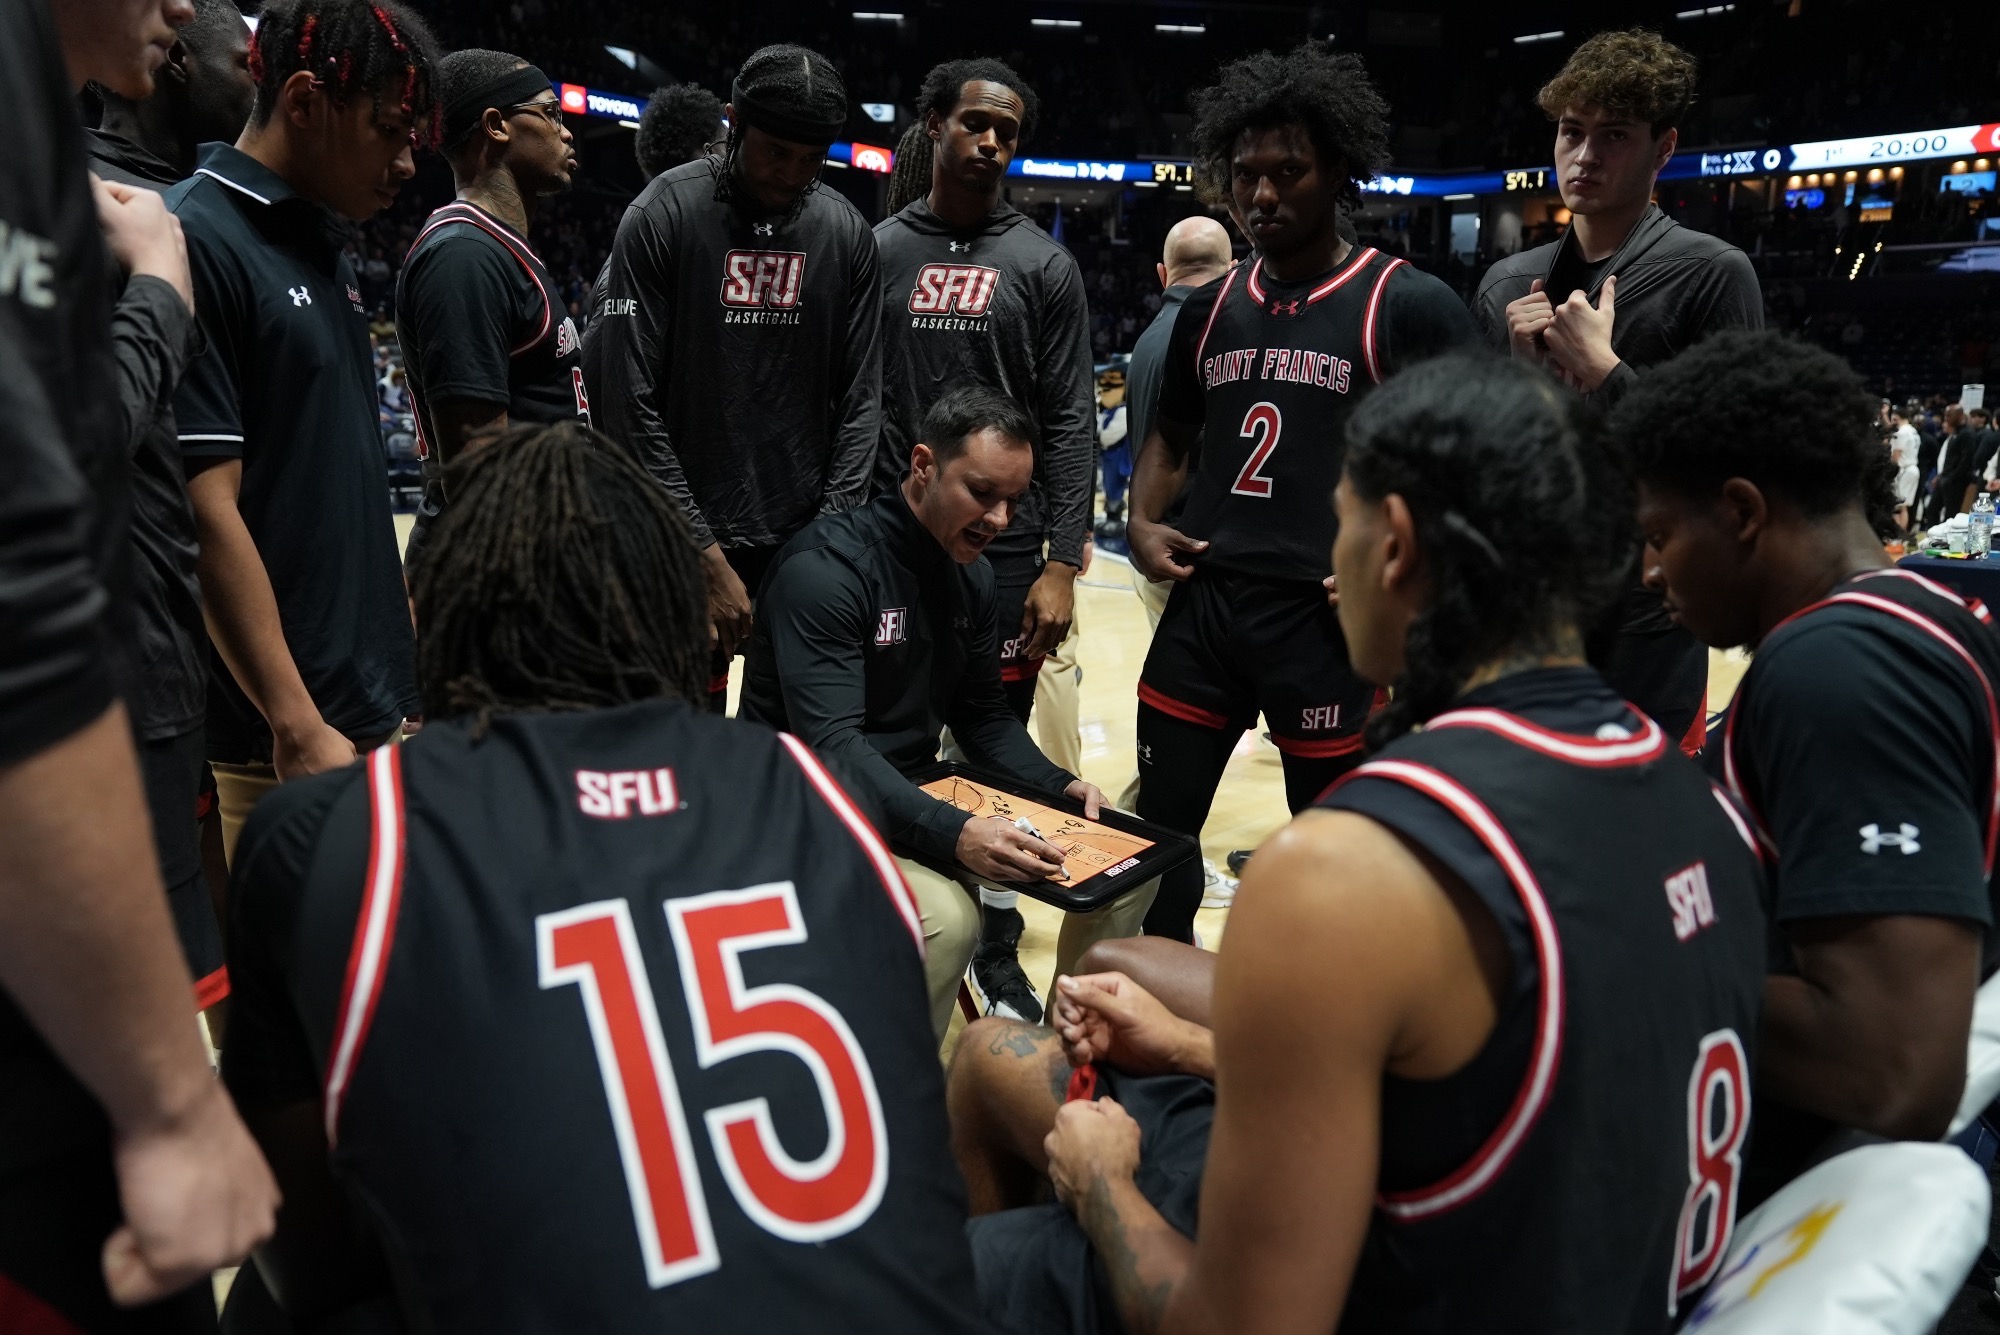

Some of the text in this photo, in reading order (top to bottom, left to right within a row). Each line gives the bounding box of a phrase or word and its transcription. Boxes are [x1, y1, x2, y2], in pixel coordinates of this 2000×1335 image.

[587, 95, 639, 119] TOYOTA
[1763, 149, 1782, 170] 0
[1869, 135, 1948, 158] 20:00
[1155, 164, 1192, 181] 57.1
[1506, 170, 1544, 190] 57.1
[721, 250, 805, 308] SFU
[909, 264, 999, 316] SFU
[725, 311, 800, 324] BASKETBALL
[912, 317, 988, 331] BASKETBALL
[1205, 349, 1351, 394] SAINT FRANCIS
[1231, 401, 1282, 498] 2
[875, 608, 907, 645] SFU
[1001, 638, 1023, 658] SF
[1301, 704, 1340, 730] SFU
[576, 768, 678, 818] SFU
[1664, 862, 1716, 941] SFU
[535, 881, 889, 1289] 15
[1668, 1028, 1751, 1318] 8
